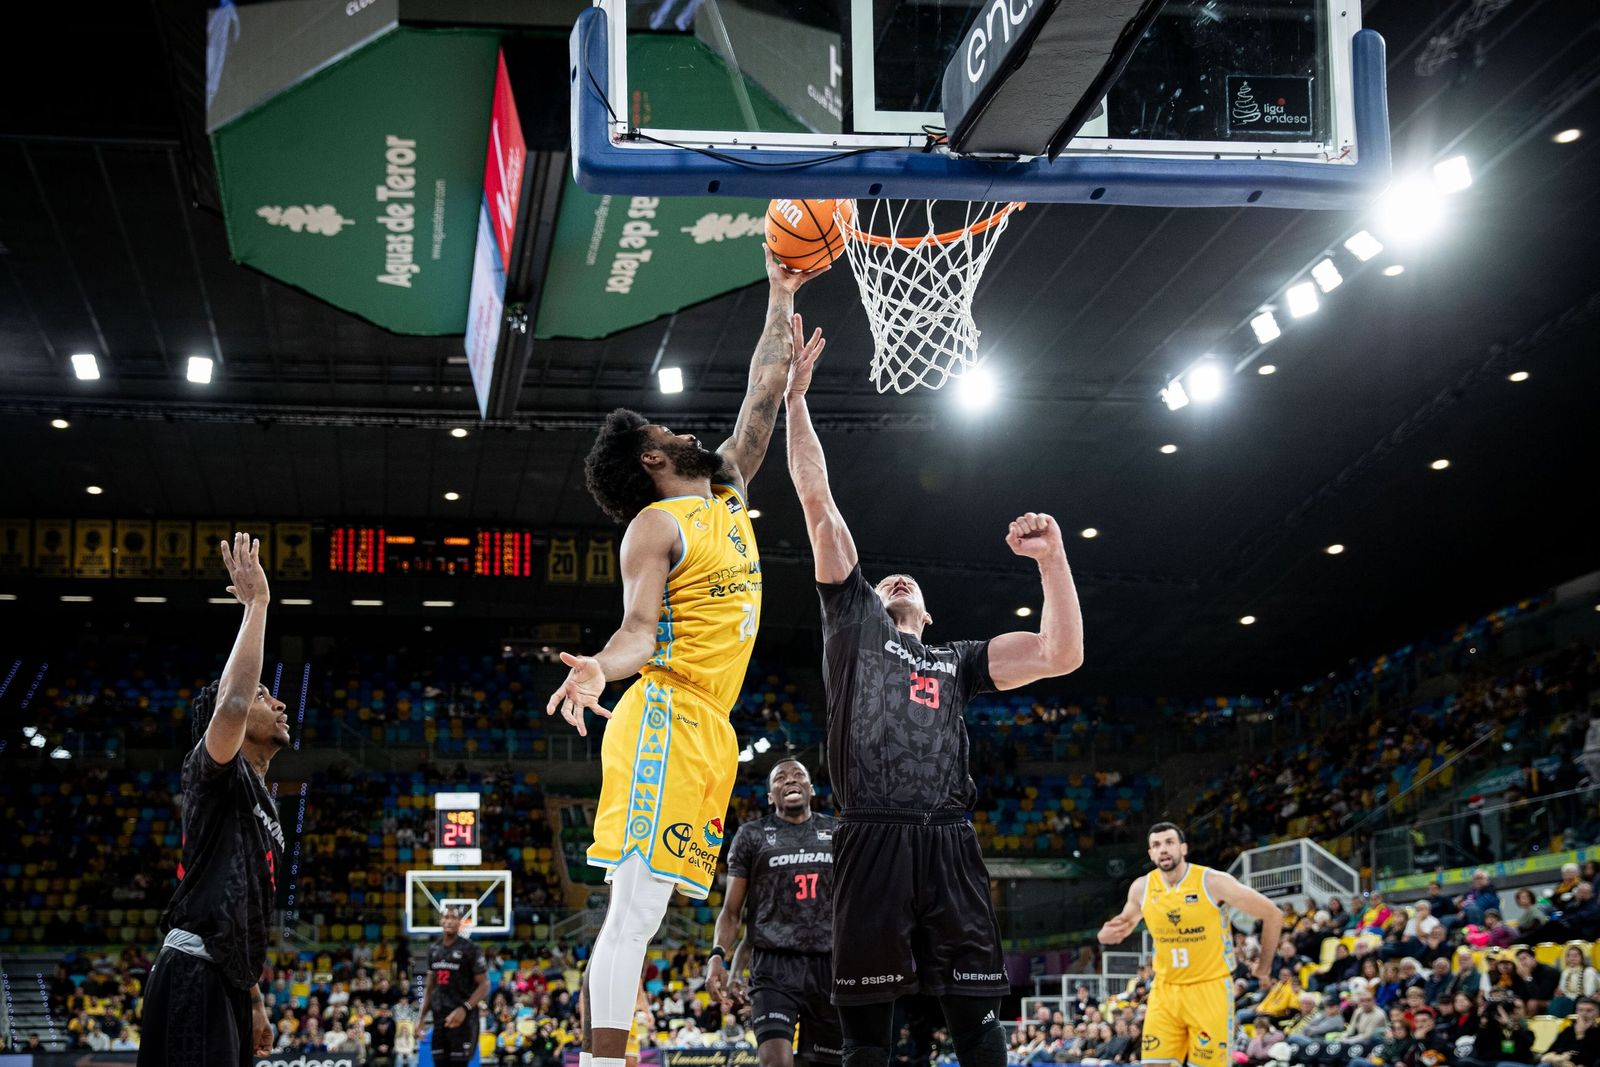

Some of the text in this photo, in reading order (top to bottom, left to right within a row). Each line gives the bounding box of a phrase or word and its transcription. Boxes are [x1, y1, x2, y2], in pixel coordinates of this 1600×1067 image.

[1263, 103, 1284, 115] liga
[1264, 114, 1308, 124] endesa
[376, 135, 421, 288] Aguas de Teror
[619, 220, 660, 249] de
[605, 249, 653, 294] Teror
[552, 553, 574, 575] 20
[592, 554, 608, 576] 11
[909, 671, 940, 710] 29
[443, 823, 472, 847] 24
[794, 872, 819, 900] 37
[1171, 948, 1190, 969] 13
[835, 974, 895, 986] vive asisa
[962, 972, 1003, 981] BERNER
